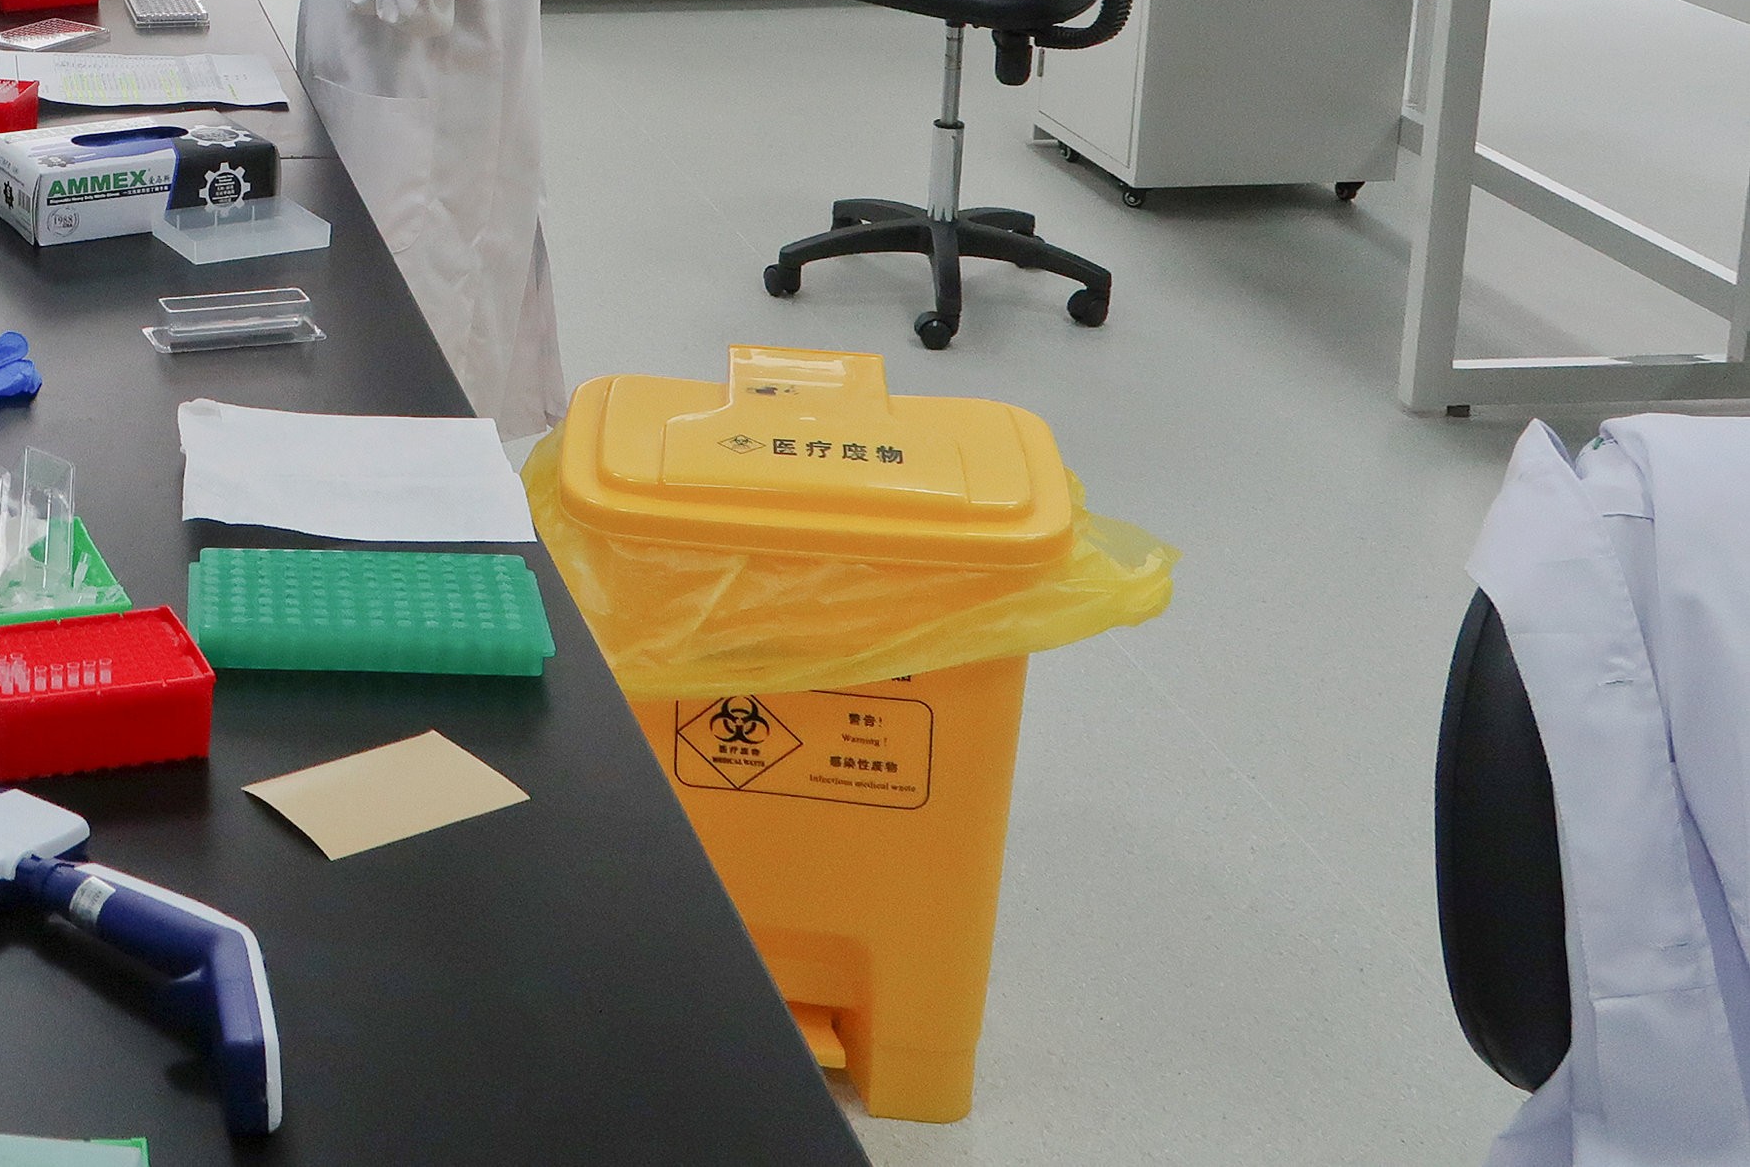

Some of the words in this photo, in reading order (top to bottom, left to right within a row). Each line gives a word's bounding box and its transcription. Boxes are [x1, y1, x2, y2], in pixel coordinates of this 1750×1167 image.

[47, 169, 147, 198] AMMEX
[54, 215, 74, 226] 1988
[772, 437, 905, 465] 医疗废物
[830, 756, 899, 774] 感染性废物
